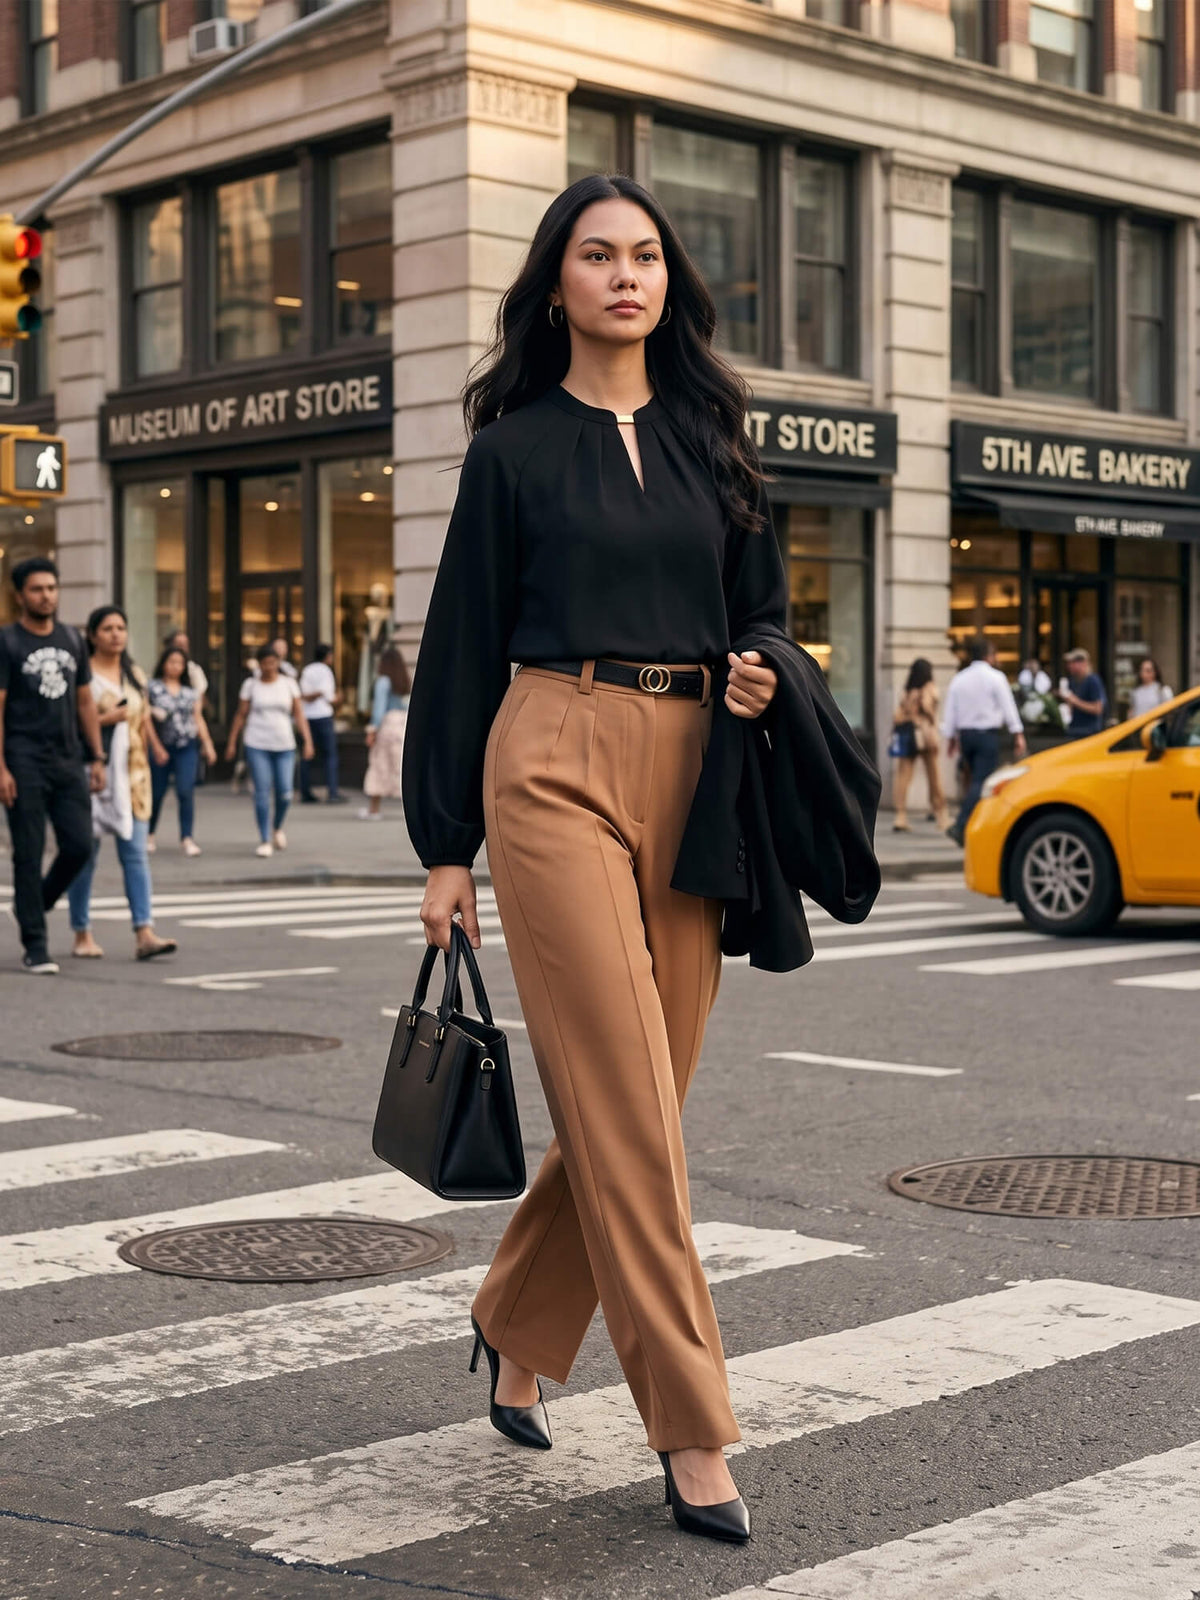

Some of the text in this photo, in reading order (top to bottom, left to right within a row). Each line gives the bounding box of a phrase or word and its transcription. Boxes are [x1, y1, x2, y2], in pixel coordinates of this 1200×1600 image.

[109, 376, 380, 445] MUSEUM OF ART STORE
[777, 414, 875, 458] STORE
[982, 437, 1191, 489] 5TH AVE. BAKERY
